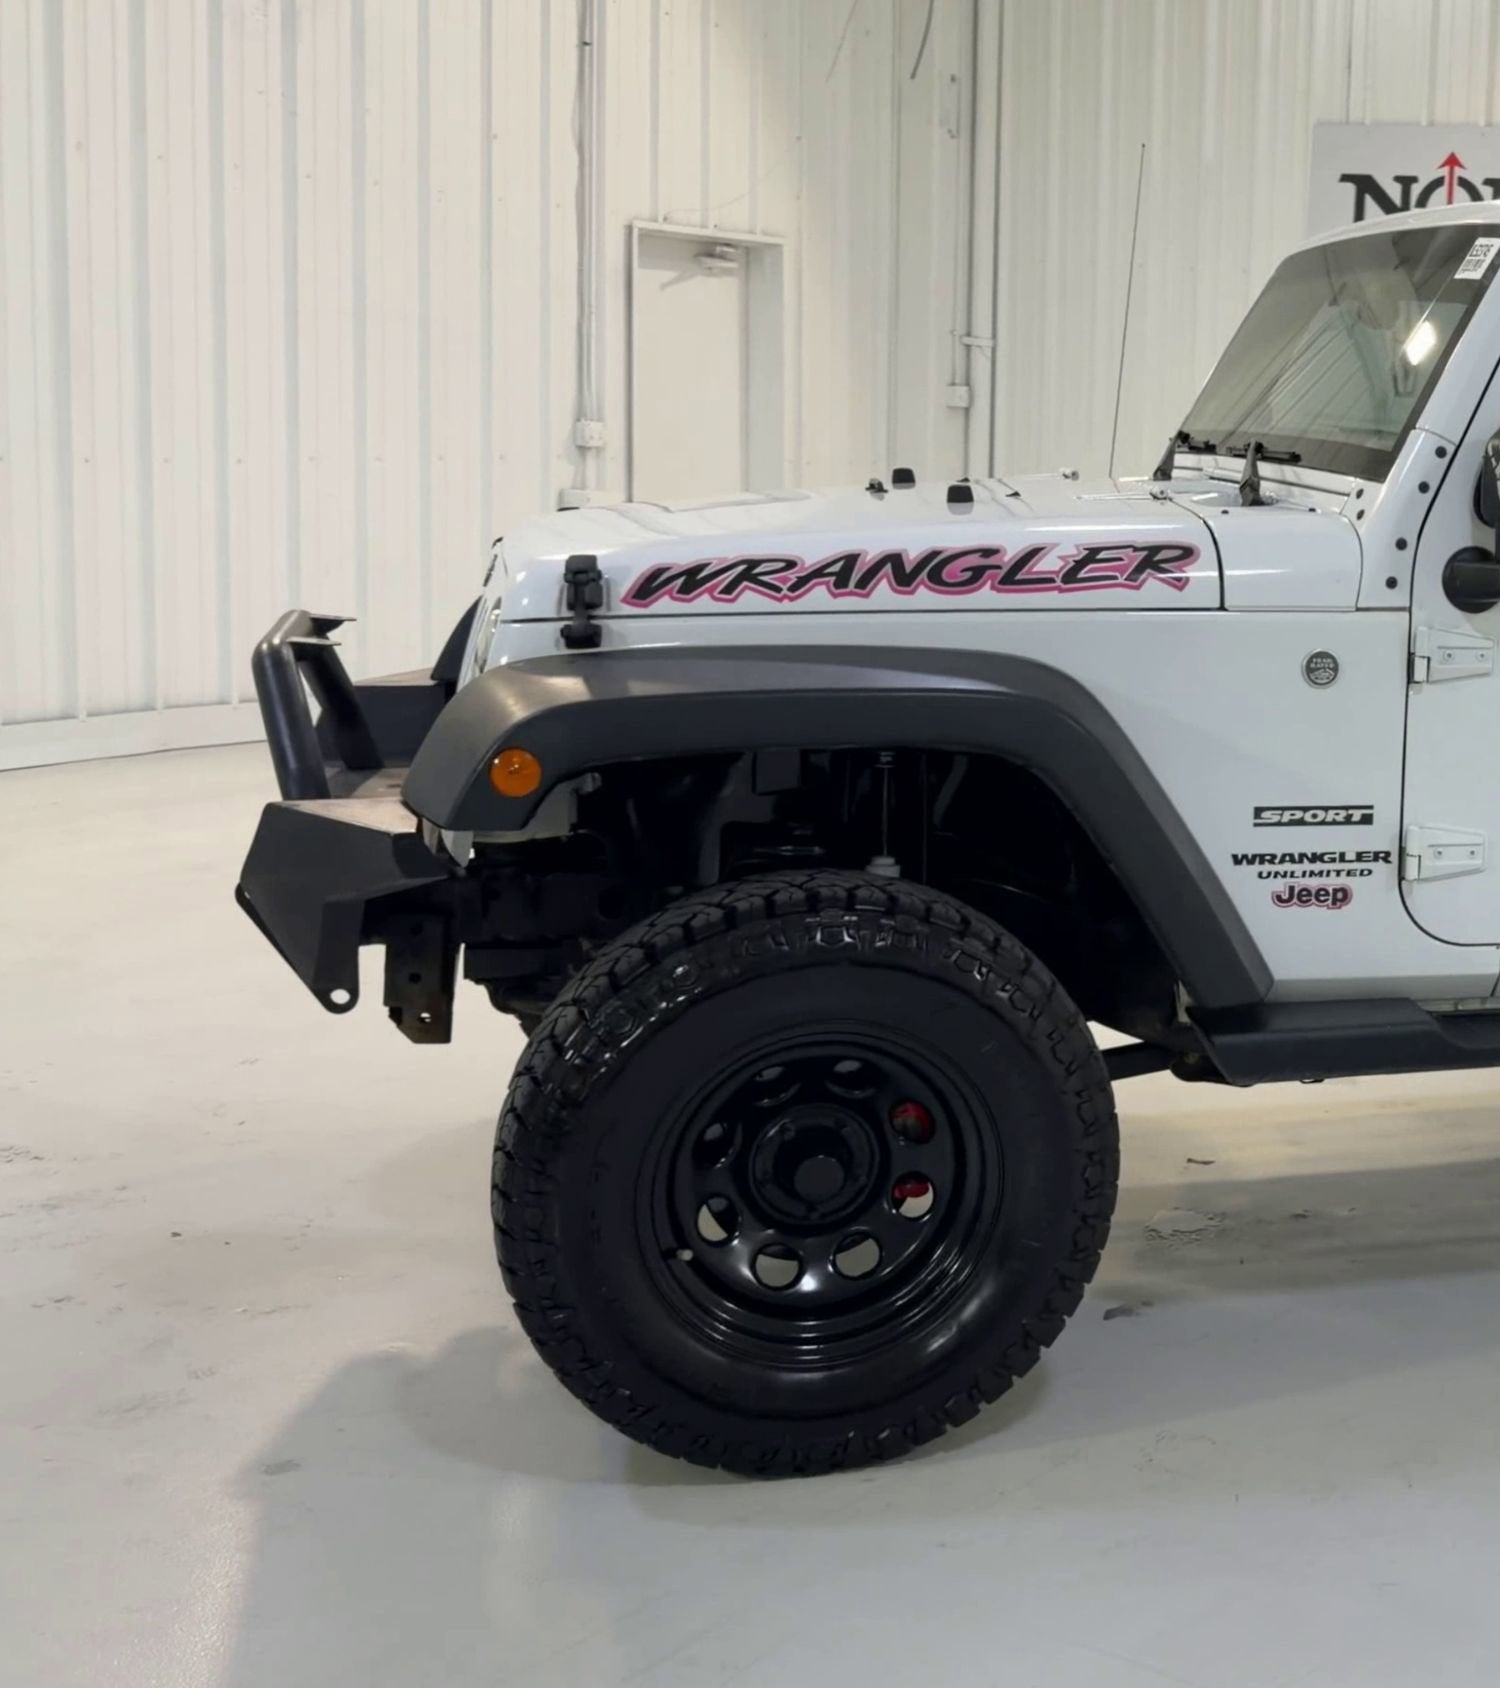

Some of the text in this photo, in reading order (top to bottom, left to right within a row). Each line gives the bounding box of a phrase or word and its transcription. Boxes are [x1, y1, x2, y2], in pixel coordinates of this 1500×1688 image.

[622, 541, 1200, 608] WRANGLER
[1254, 808, 1373, 825] SPORT
[1231, 851, 1393, 867] WRANGLER
[1257, 868, 1373, 880] UNLIMITED
[1273, 883, 1352, 908] Jeep
